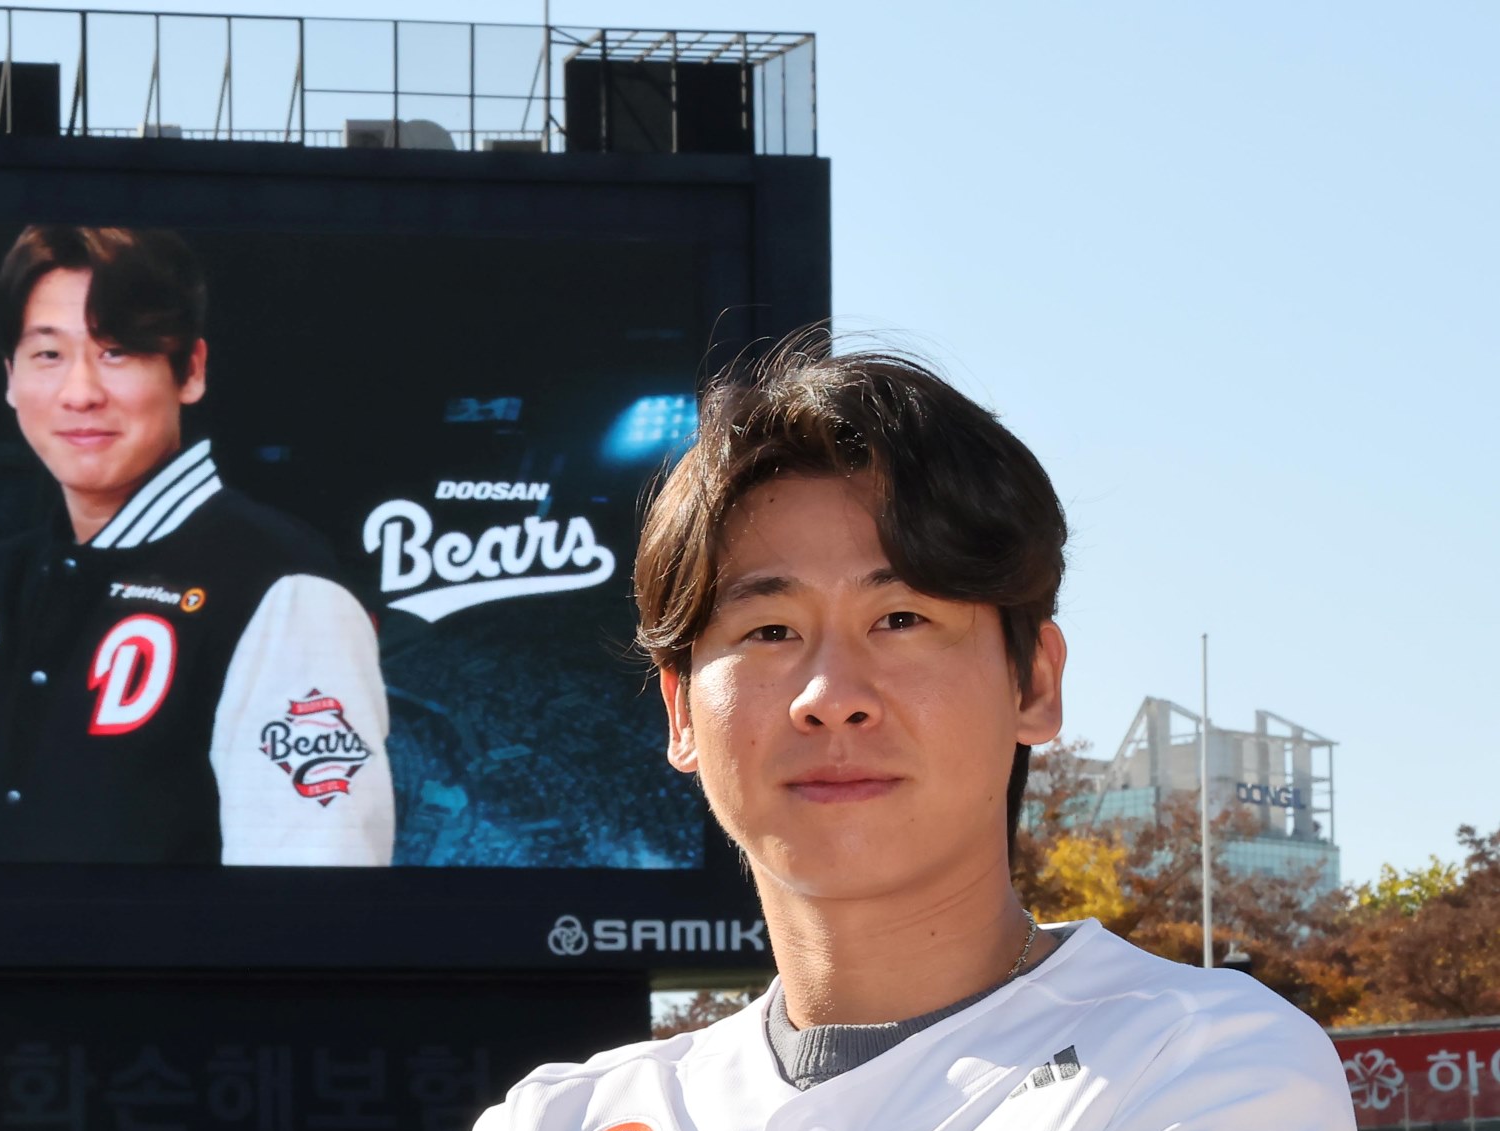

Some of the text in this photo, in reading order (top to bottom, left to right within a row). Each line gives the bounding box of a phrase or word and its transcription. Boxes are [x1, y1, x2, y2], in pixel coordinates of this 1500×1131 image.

[435, 481, 549, 500] DOOSAN
[362, 499, 616, 612] Bears
[87, 613, 178, 737] D
[260, 721, 372, 763] Bears
[1426, 1049, 1500, 1096] 하
